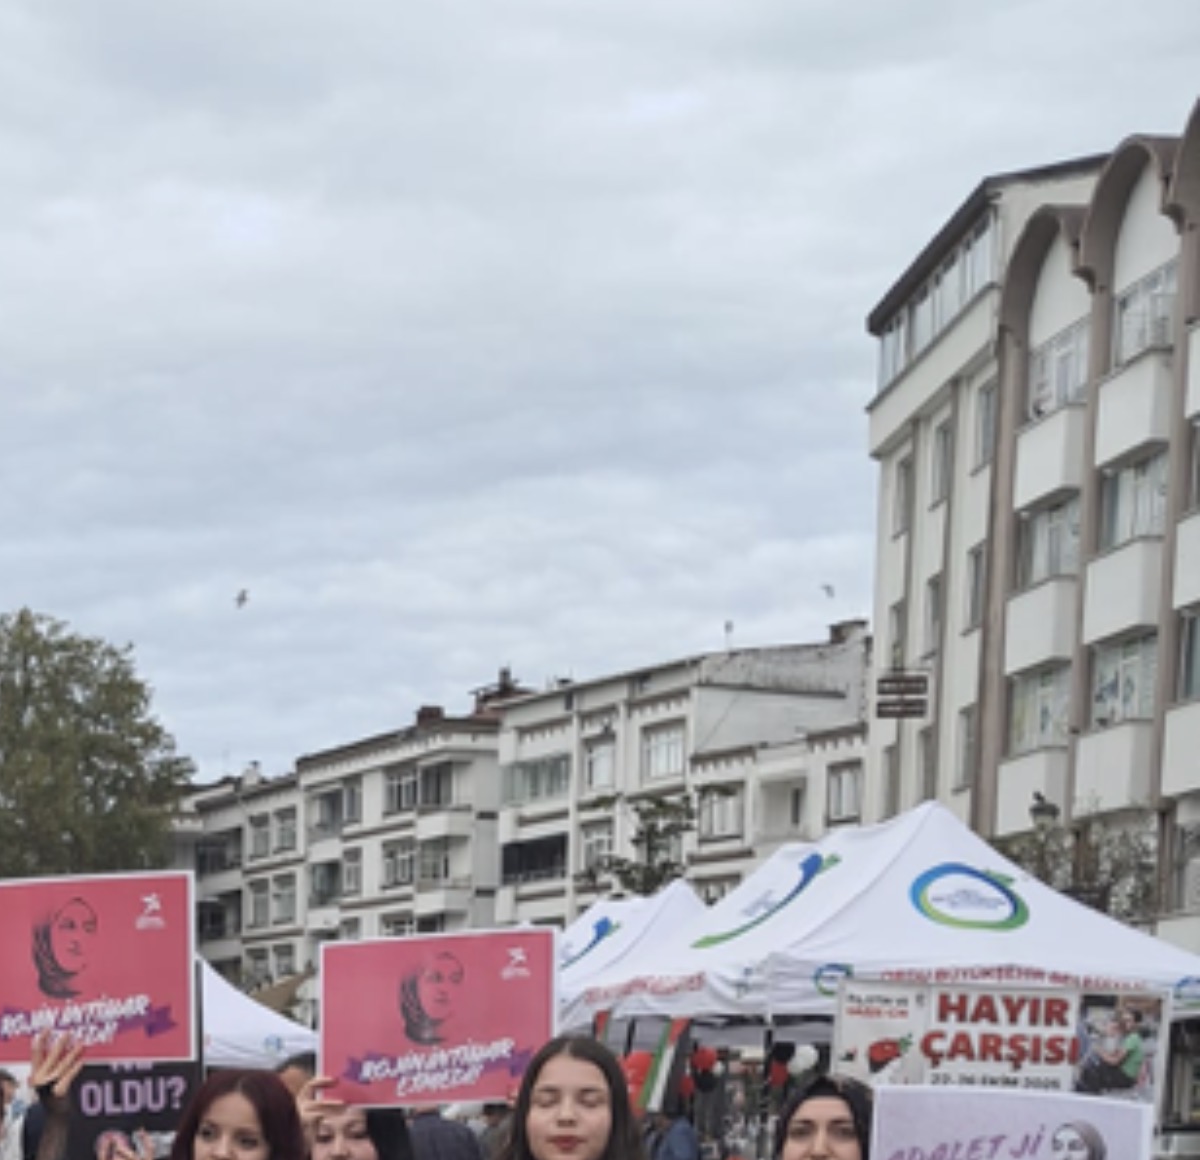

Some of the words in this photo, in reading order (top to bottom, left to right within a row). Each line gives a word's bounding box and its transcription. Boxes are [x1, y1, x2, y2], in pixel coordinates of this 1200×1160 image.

[937, 992, 1070, 1027] HAYIR
[921, 1030, 1080, 1070] ÇARŞISI
[80, 1076, 186, 1116] OLDU?
